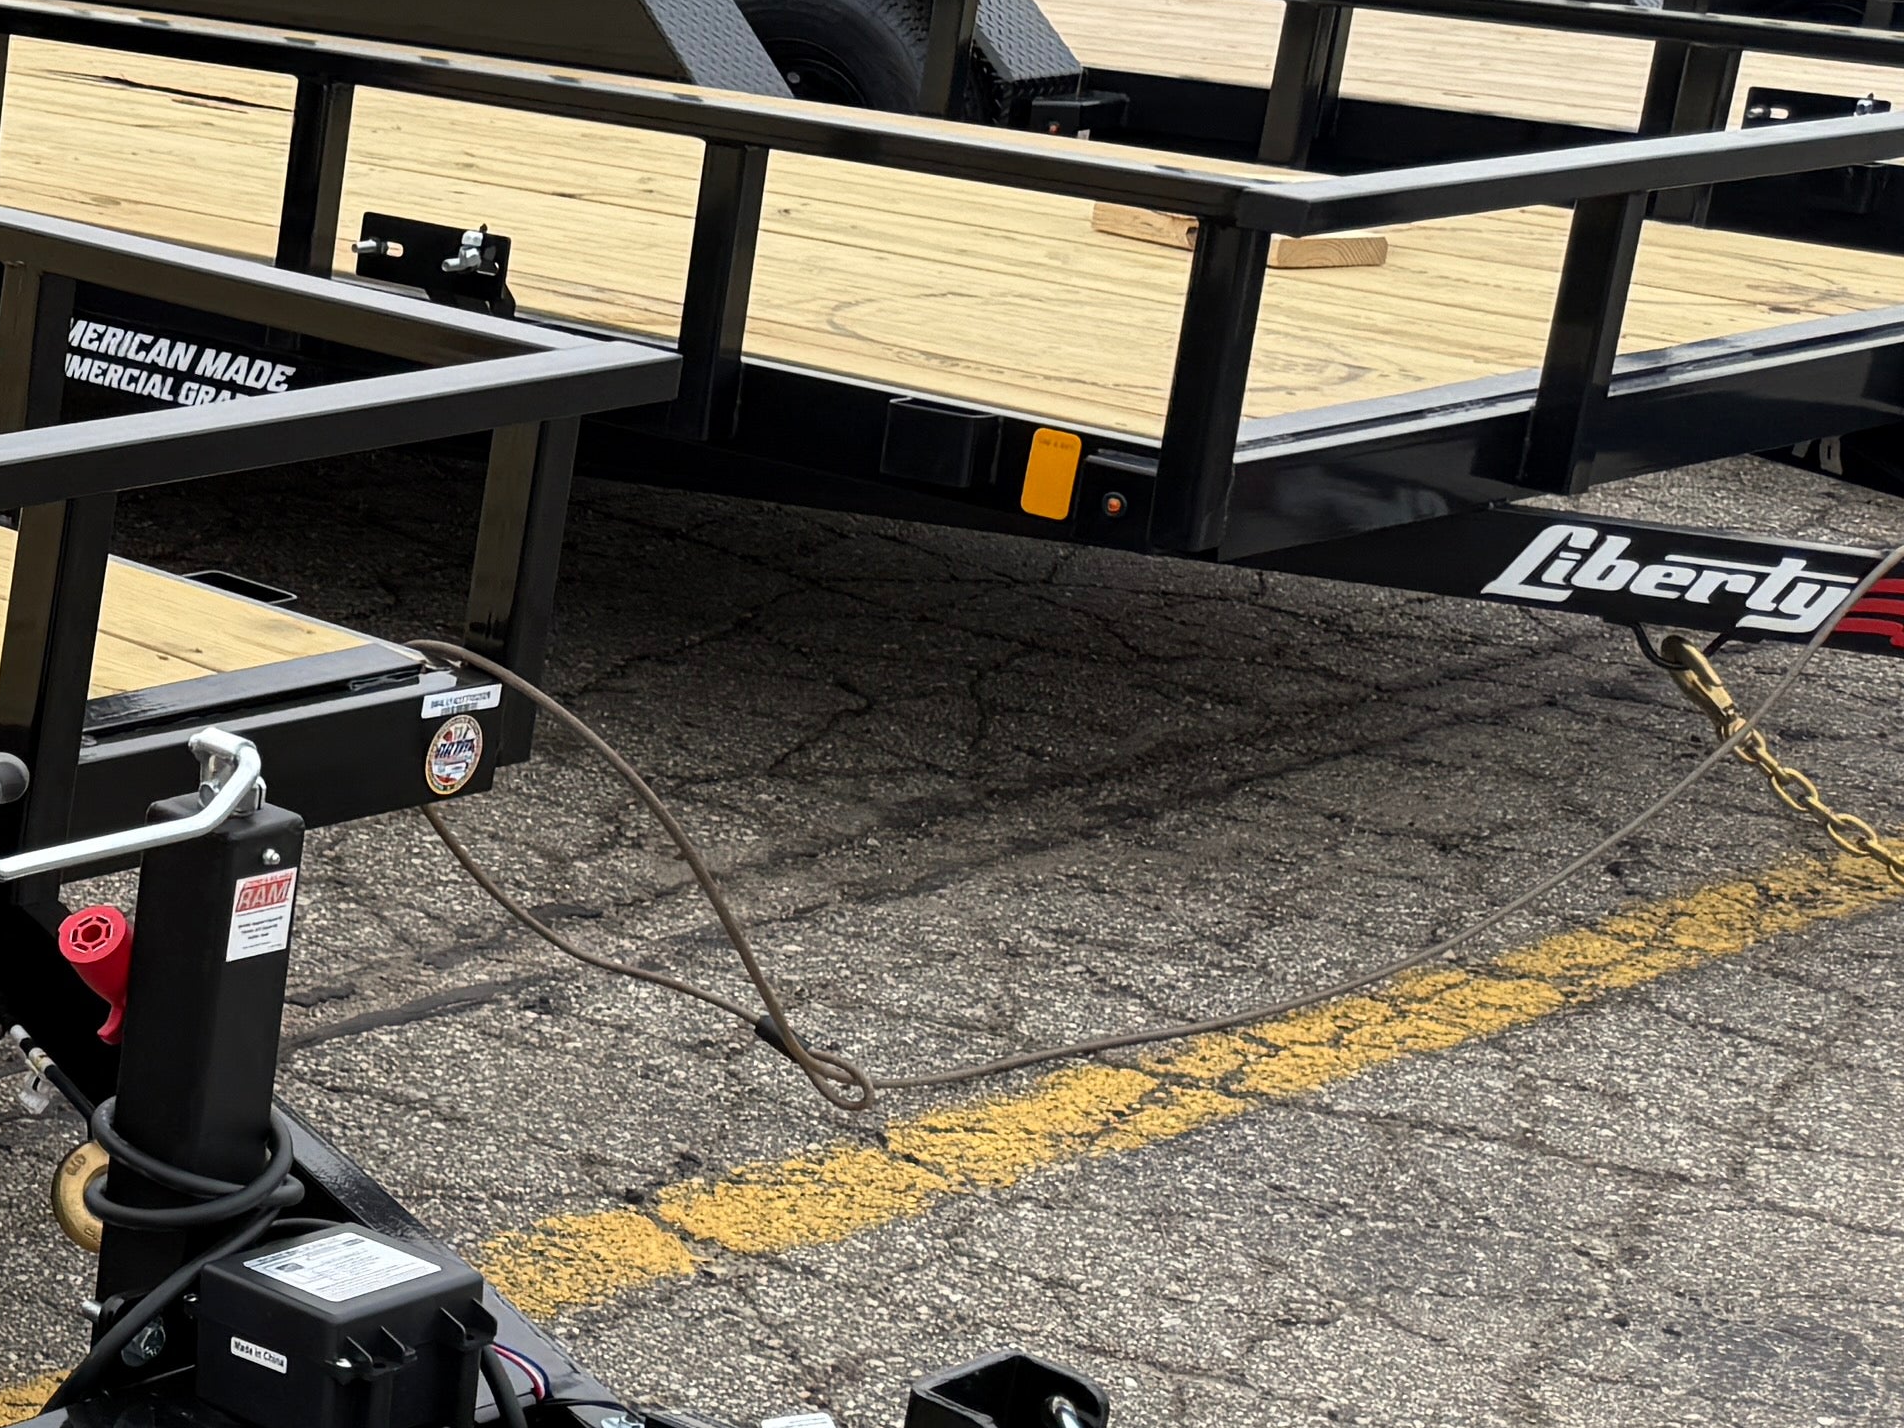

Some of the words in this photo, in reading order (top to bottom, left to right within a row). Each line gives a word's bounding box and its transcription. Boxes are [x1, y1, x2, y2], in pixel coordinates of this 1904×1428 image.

[64, 353, 174, 402] MERCIAL
[68, 317, 198, 372] MERICAN
[194, 348, 296, 393] MADE
[1480, 524, 1859, 633] Liberty
[236, 879, 291, 912] RAM
